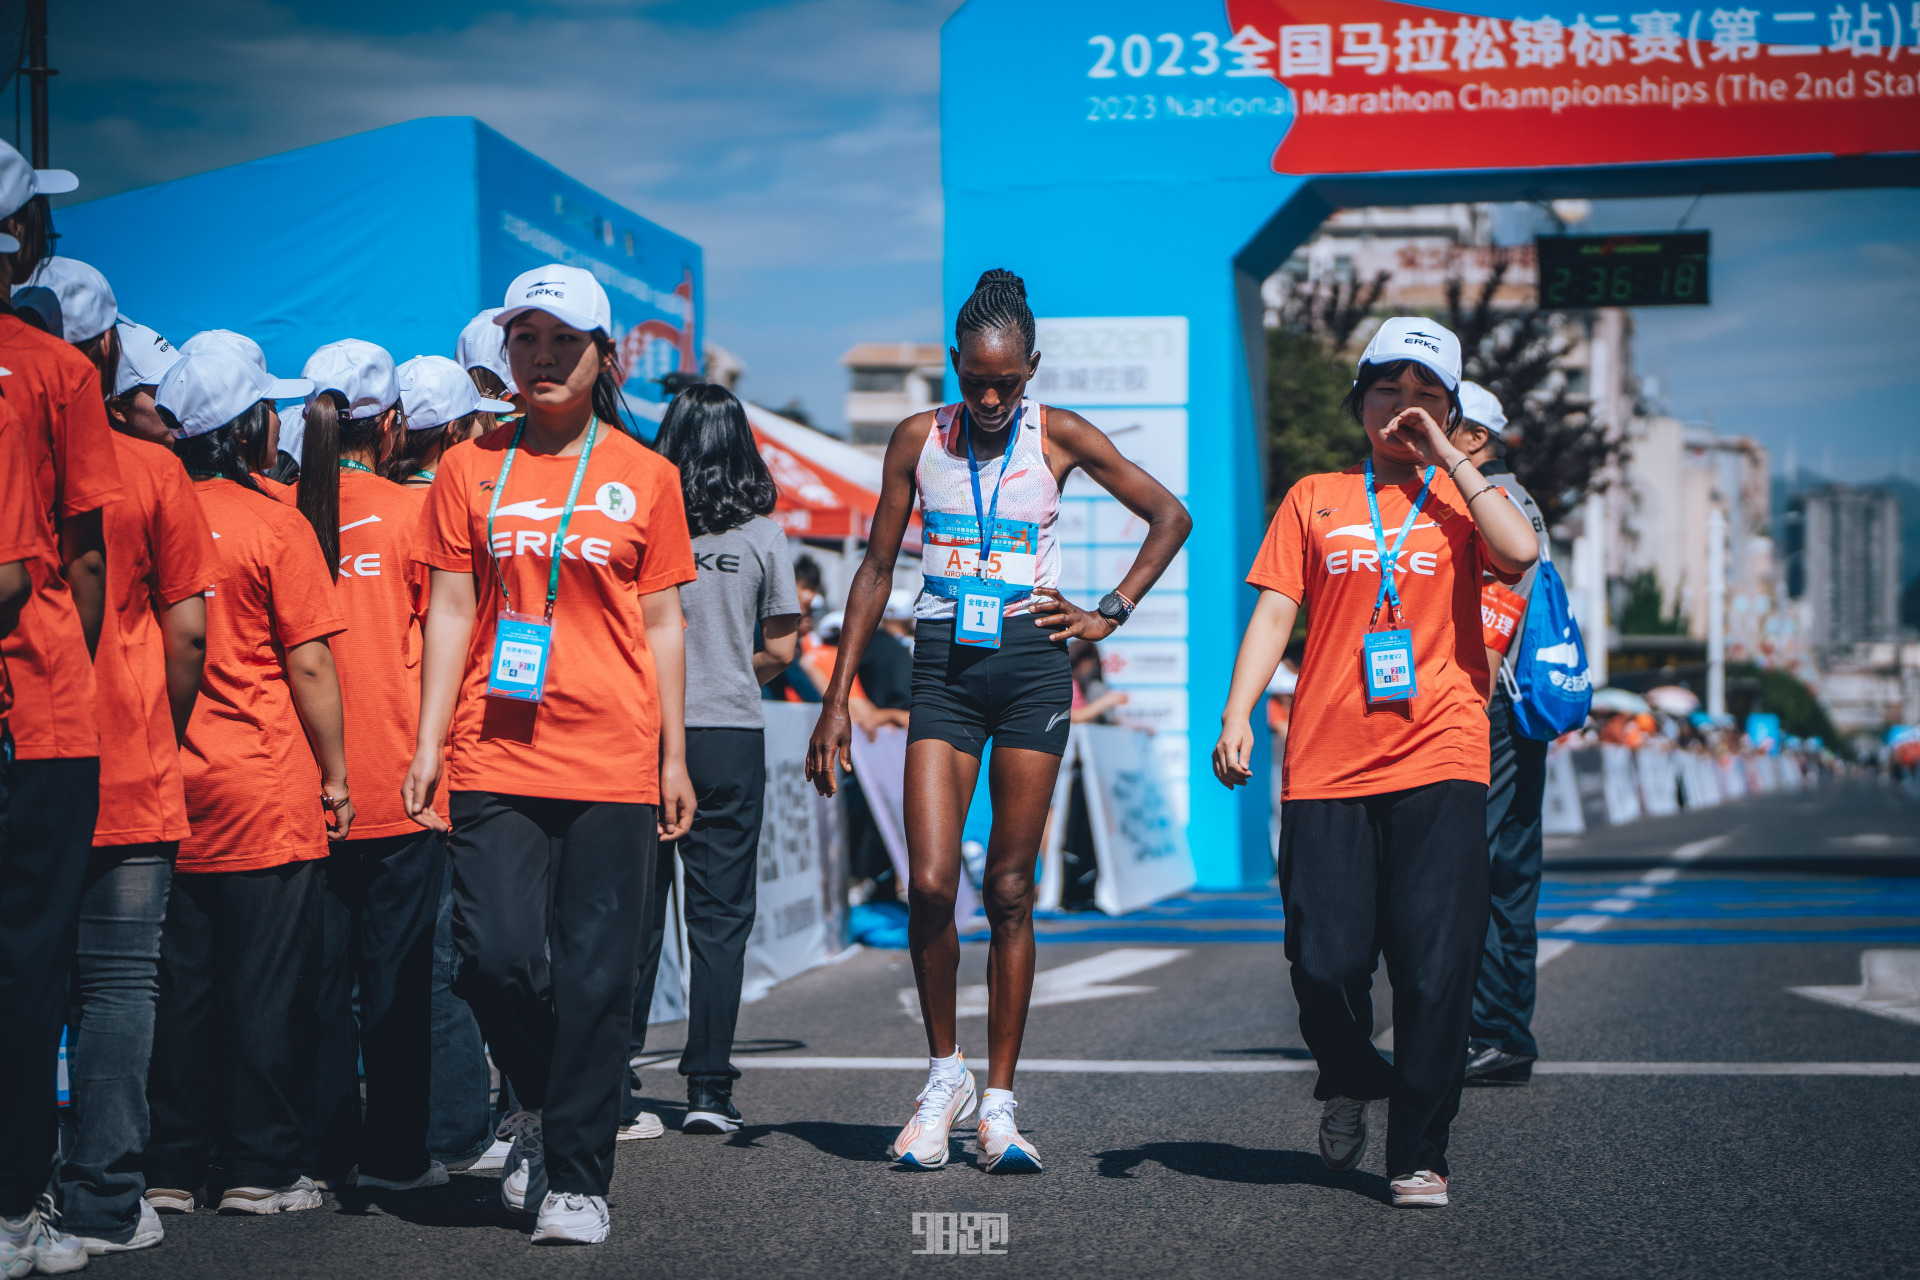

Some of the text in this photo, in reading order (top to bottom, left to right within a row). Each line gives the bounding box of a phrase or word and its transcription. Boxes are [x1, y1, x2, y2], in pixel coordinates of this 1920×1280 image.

[1087, 95, 1157, 120] 2023
[1165, 89, 1296, 117] National
[1302, 84, 1455, 115] Marathon
[1458, 75, 1709, 113] Championships
[1715, 71, 1789, 106] (The
[1795, 69, 1855, 99] 2nd
[526, 289, 564, 299] ERKE
[1404, 338, 1440, 354] ERKE
[487, 531, 612, 566] ERKE
[1326, 549, 1437, 576] ERKE
[968, 598, 997, 609] 全程女子
[976, 611, 985, 627] 1
[1481, 604, 1515, 637] 助理
